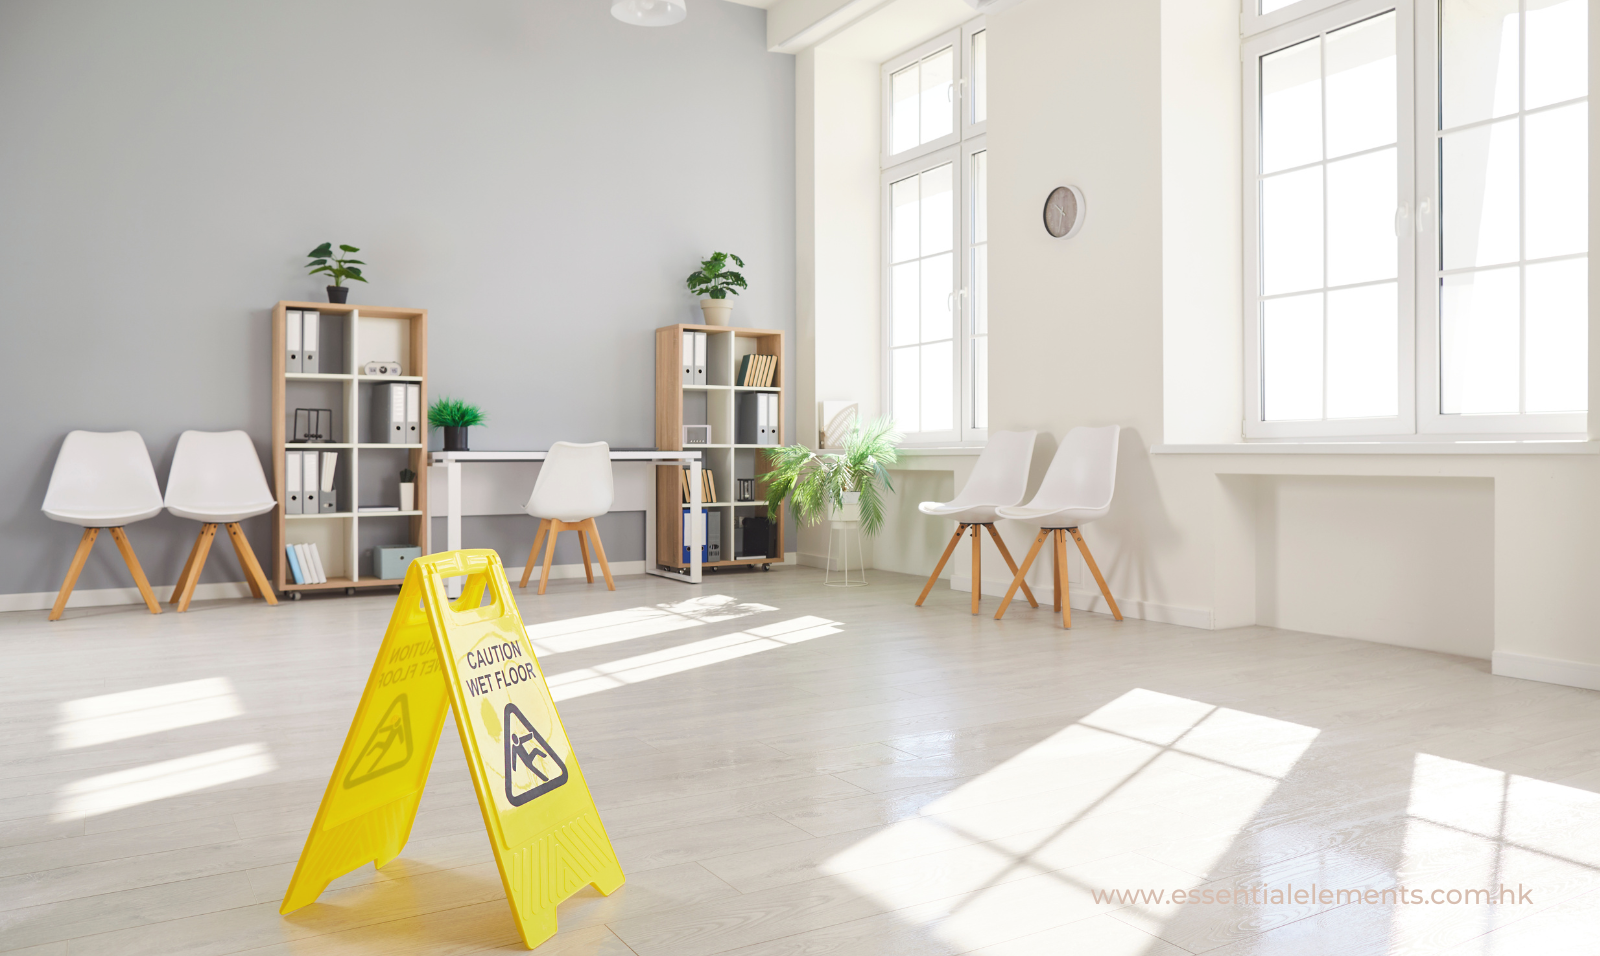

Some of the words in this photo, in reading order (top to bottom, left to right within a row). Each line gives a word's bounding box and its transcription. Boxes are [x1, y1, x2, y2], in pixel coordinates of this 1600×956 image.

[466, 640, 523, 670] CAUTION
[465, 674, 494, 698] WET
[494, 662, 537, 690] FLOOR
